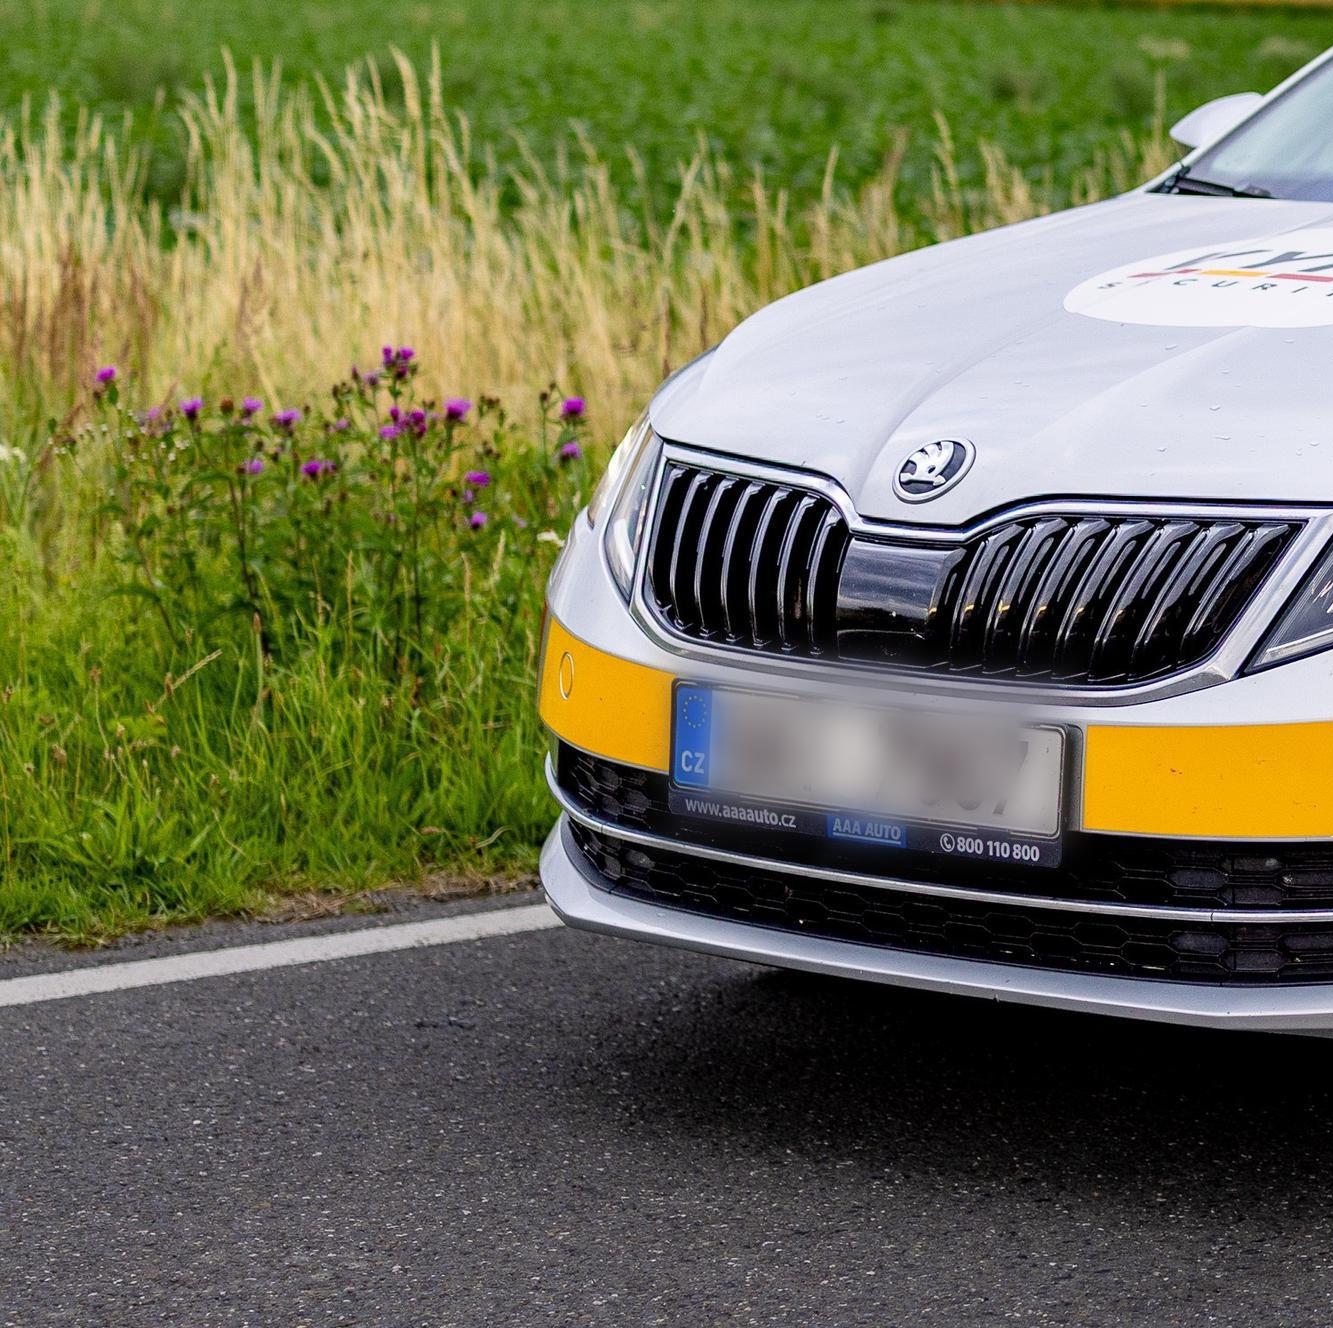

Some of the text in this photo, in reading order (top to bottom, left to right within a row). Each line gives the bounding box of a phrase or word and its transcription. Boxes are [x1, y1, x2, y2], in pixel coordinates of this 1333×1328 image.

[681, 749, 706, 774] CZ
[685, 798, 797, 829] www.aaaauto.cz
[832, 817, 902, 841] AAA AUTO
[956, 836, 1041, 862] 800 110 800
